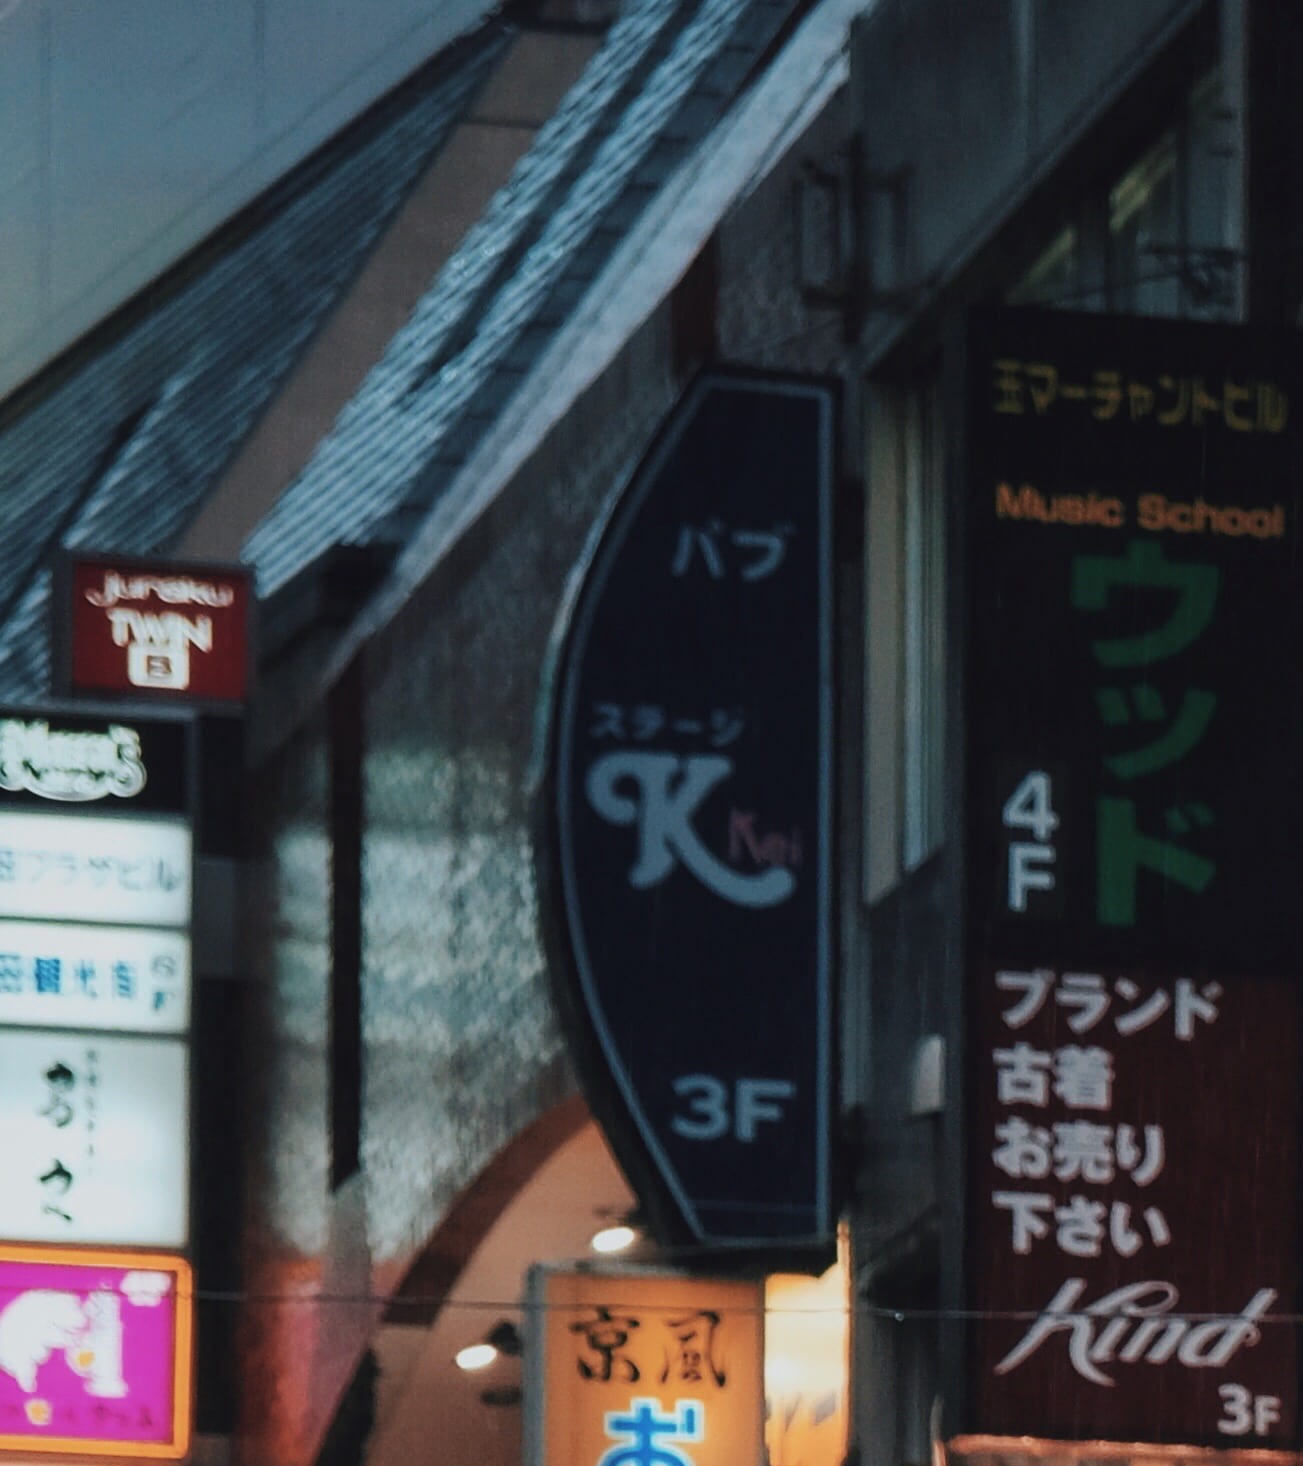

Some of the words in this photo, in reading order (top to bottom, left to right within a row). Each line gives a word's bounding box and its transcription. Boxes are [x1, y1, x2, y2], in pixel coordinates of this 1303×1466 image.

[995, 482, 1125, 528] Music
[1137, 491, 1286, 539] School
[672, 524, 796, 579] パブ
[590, 705, 744, 747] ステージ
[1071, 540, 1219, 926] ウッド
[994, 968, 1223, 1041] ブランド
[671, 1076, 796, 1143] 3F
[992, 1043, 1114, 1111] 古着
[992, 1117, 1164, 1187] お売り
[992, 1190, 1171, 1258] 下さい
[569, 1306, 729, 1389] 京風
[993, 1277, 1279, 1388] Kind
[1217, 1383, 1282, 1437] 3F
